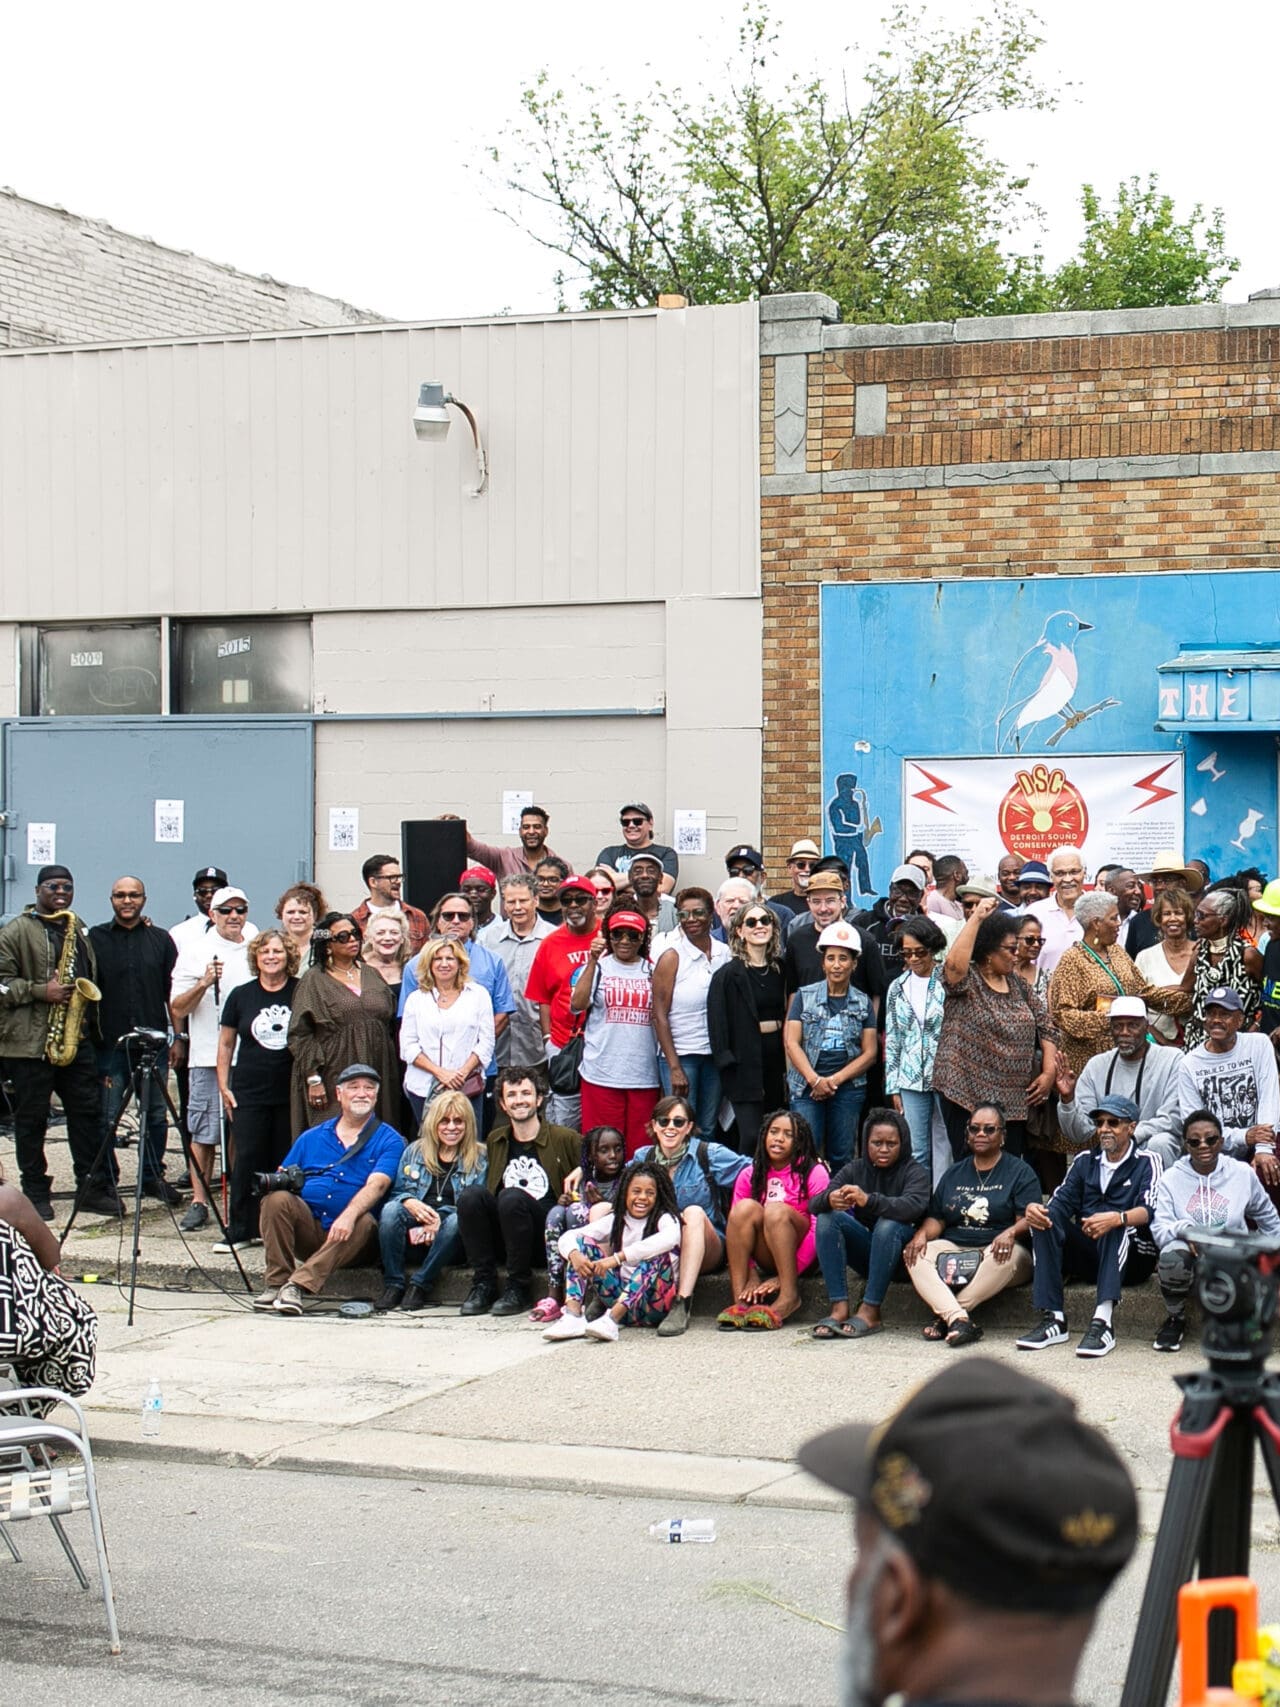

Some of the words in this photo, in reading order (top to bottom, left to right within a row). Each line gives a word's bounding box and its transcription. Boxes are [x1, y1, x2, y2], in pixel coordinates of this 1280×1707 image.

[219, 637, 249, 656] 5015
[1160, 684, 1240, 717] THE
[1016, 765, 1065, 797] DSC
[1010, 833, 1045, 841] DETROIT
